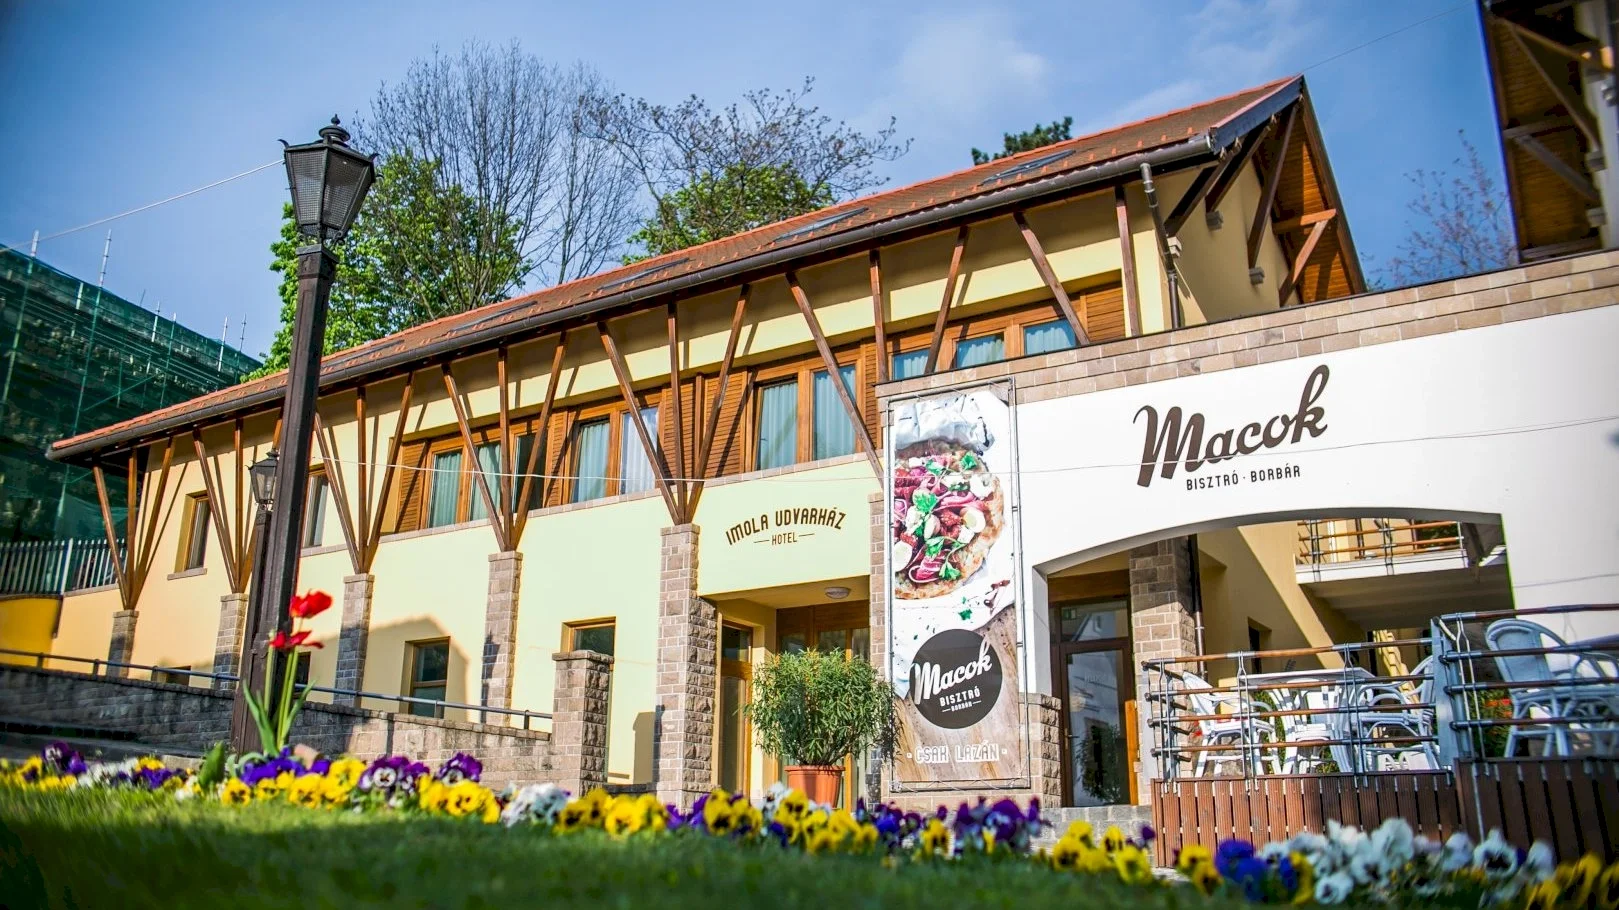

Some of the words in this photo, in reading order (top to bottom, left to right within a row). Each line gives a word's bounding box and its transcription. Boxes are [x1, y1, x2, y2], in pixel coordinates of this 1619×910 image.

[1133, 364, 1330, 488] Macok
[1186, 470, 1239, 491] BISZTRÓ
[1250, 463, 1301, 483] BORBÁR
[725, 514, 769, 546] IMOLA
[775, 507, 847, 530] UDVARHÁZ
[771, 532, 798, 546] HOTEL
[909, 635, 993, 705] Macok
[940, 685, 981, 707] BISZTRÓ
[915, 745, 949, 764] CSAK
[955, 740, 1000, 763] LAZÁN
